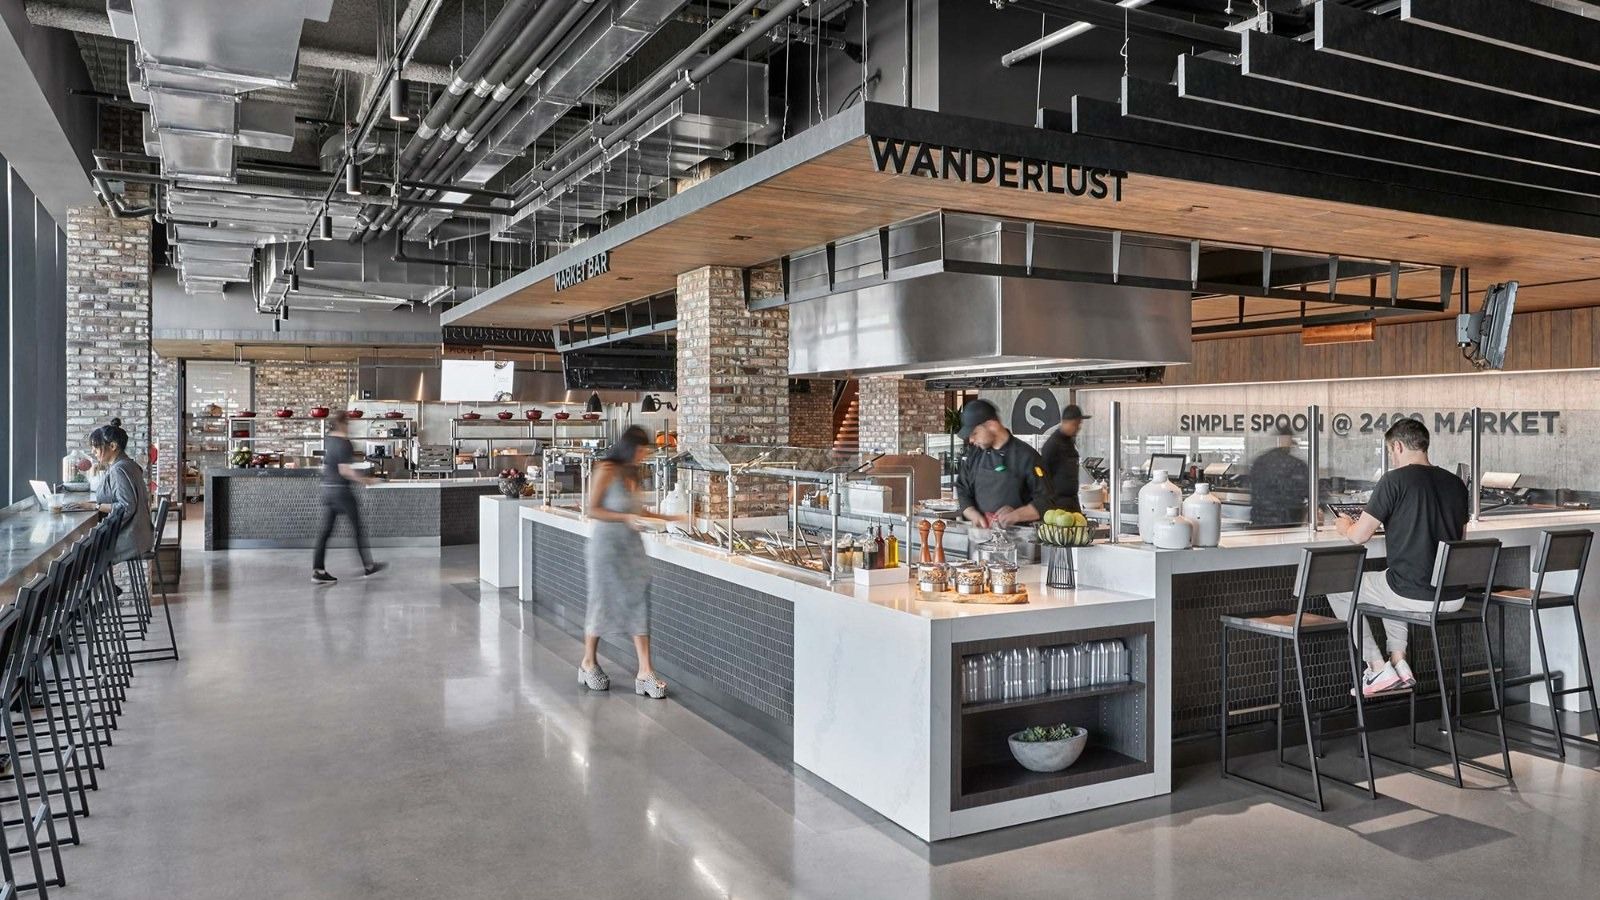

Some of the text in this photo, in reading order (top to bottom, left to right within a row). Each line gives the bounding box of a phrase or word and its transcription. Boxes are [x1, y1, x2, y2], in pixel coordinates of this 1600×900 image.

[866, 135, 1129, 202] WANDERLUST
[554, 251, 607, 292] MARKET BAR
[1180, 414, 1245, 432] SIMPLE
[1332, 413, 1352, 436] @
[1434, 411, 1560, 434] MARKET
